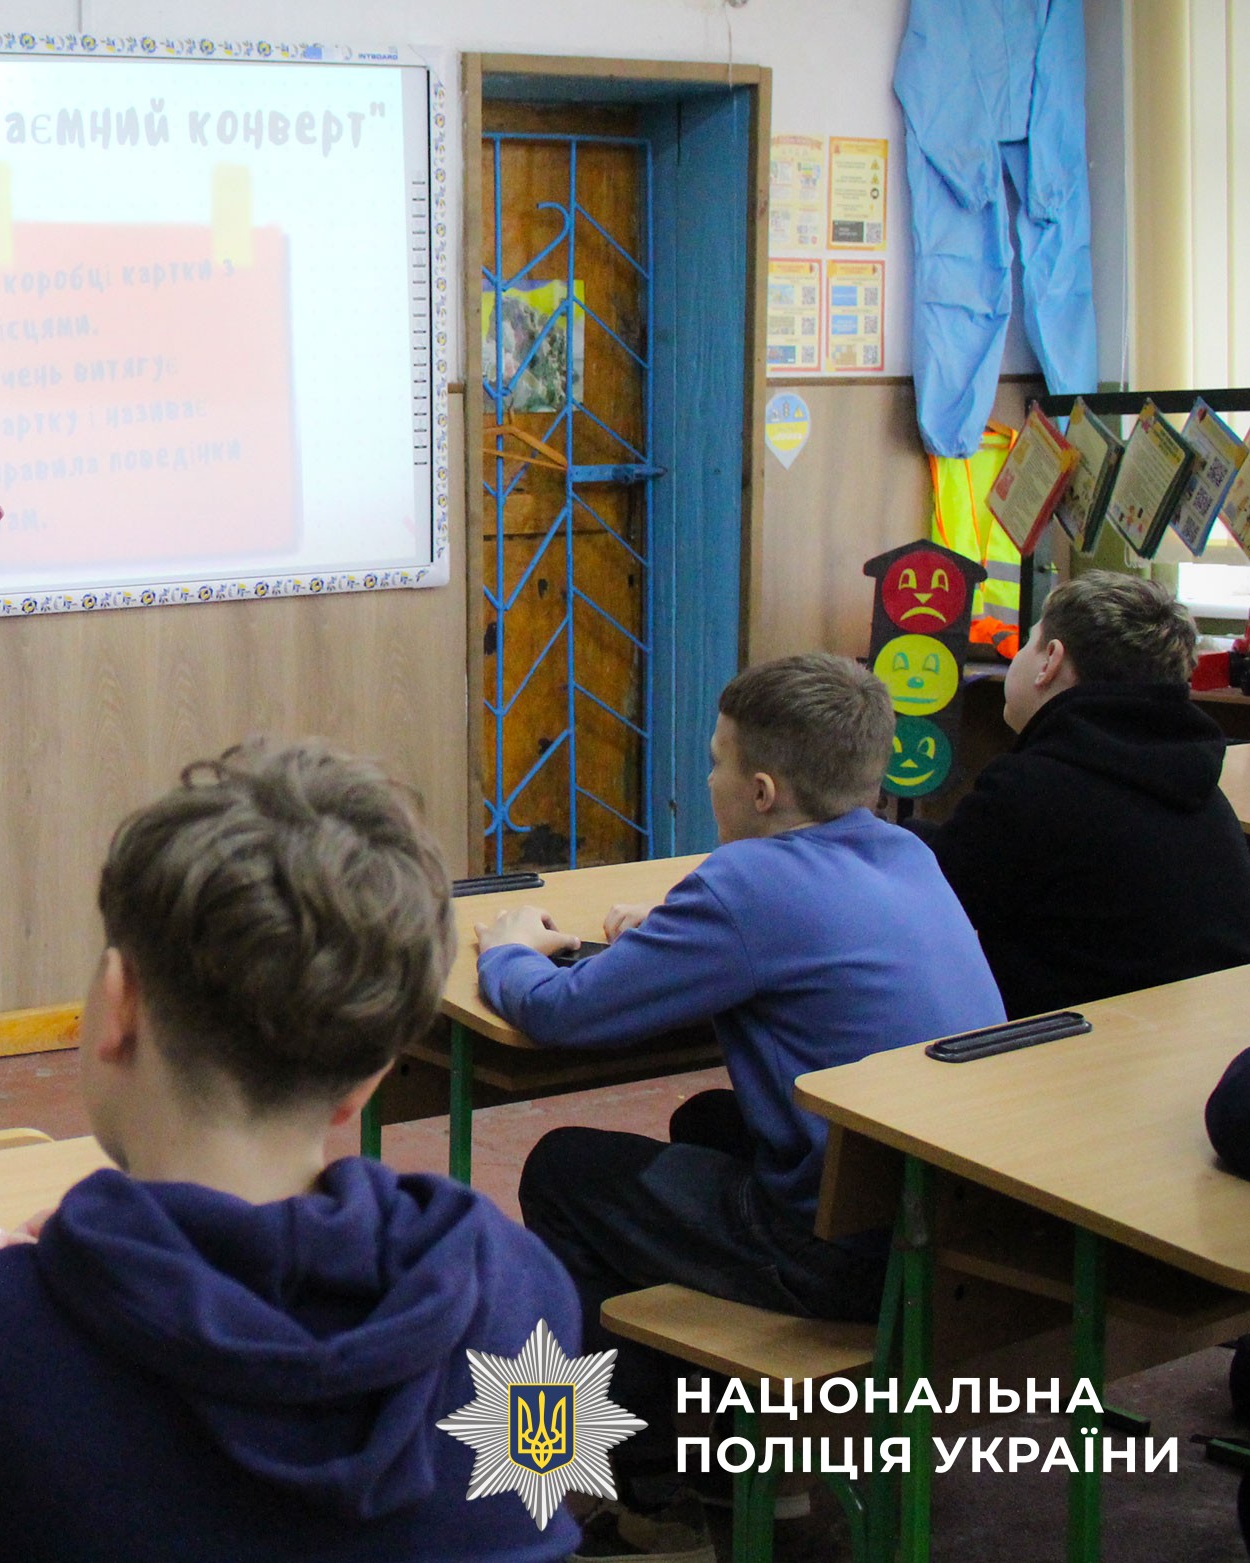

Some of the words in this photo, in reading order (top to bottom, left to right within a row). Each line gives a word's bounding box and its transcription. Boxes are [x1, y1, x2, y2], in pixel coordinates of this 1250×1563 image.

[3, 262, 111, 300] коробці
[121, 256, 213, 290] картки
[222, 257, 236, 278] з
[73, 354, 178, 384] витягує
[105, 400, 207, 429] називає
[109, 437, 242, 471] поведінки
